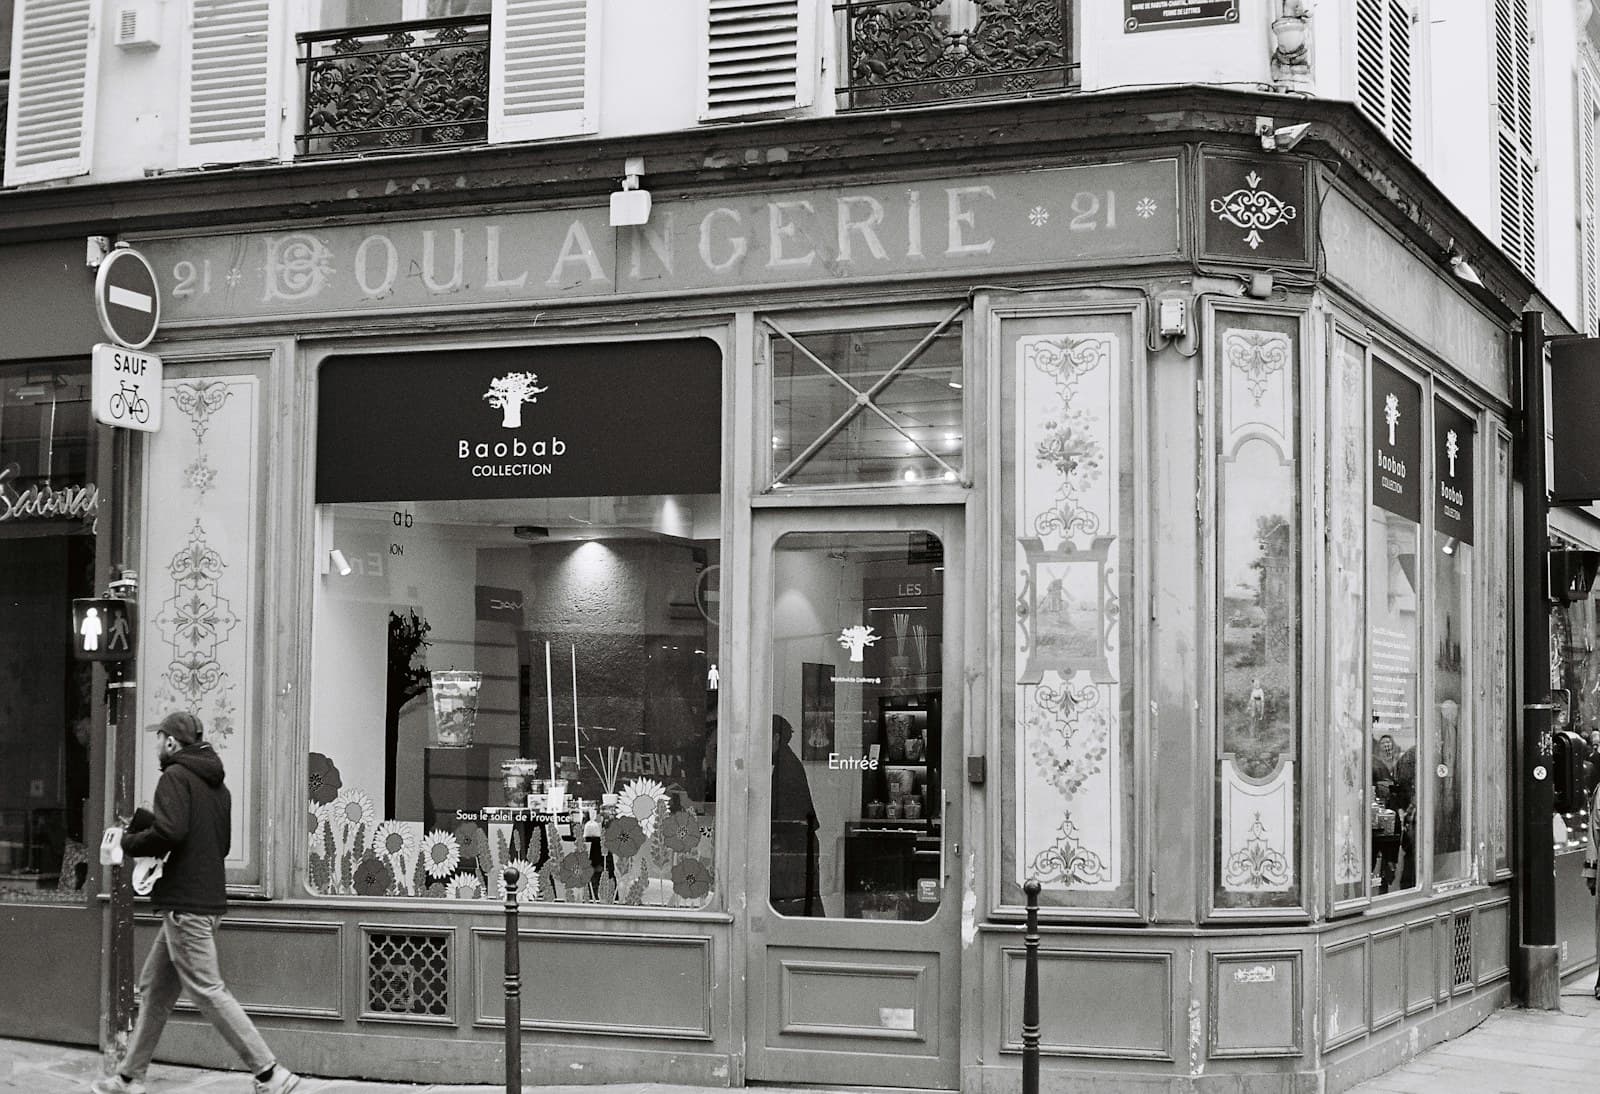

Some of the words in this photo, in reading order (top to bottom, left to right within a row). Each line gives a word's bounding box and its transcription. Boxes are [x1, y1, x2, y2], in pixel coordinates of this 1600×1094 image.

[173, 260, 212, 297] 21
[257, 185, 997, 302] BOULANGERIE
[1069, 190, 1117, 232] 21
[113, 353, 148, 377] SAUF
[458, 436, 566, 459] Baobab
[471, 463, 552, 477] COLLECTION
[1377, 449, 1406, 479] Baobab
[1441, 480, 1463, 506] Baobab
[898, 583, 922, 596] LES
[828, 752, 879, 770] Entrée
[456, 809, 478, 821] Sous
[480, 808, 489, 821] le
[490, 809, 513, 821] soleil
[515, 809, 528, 821] de
[530, 811, 570, 823] Provence
